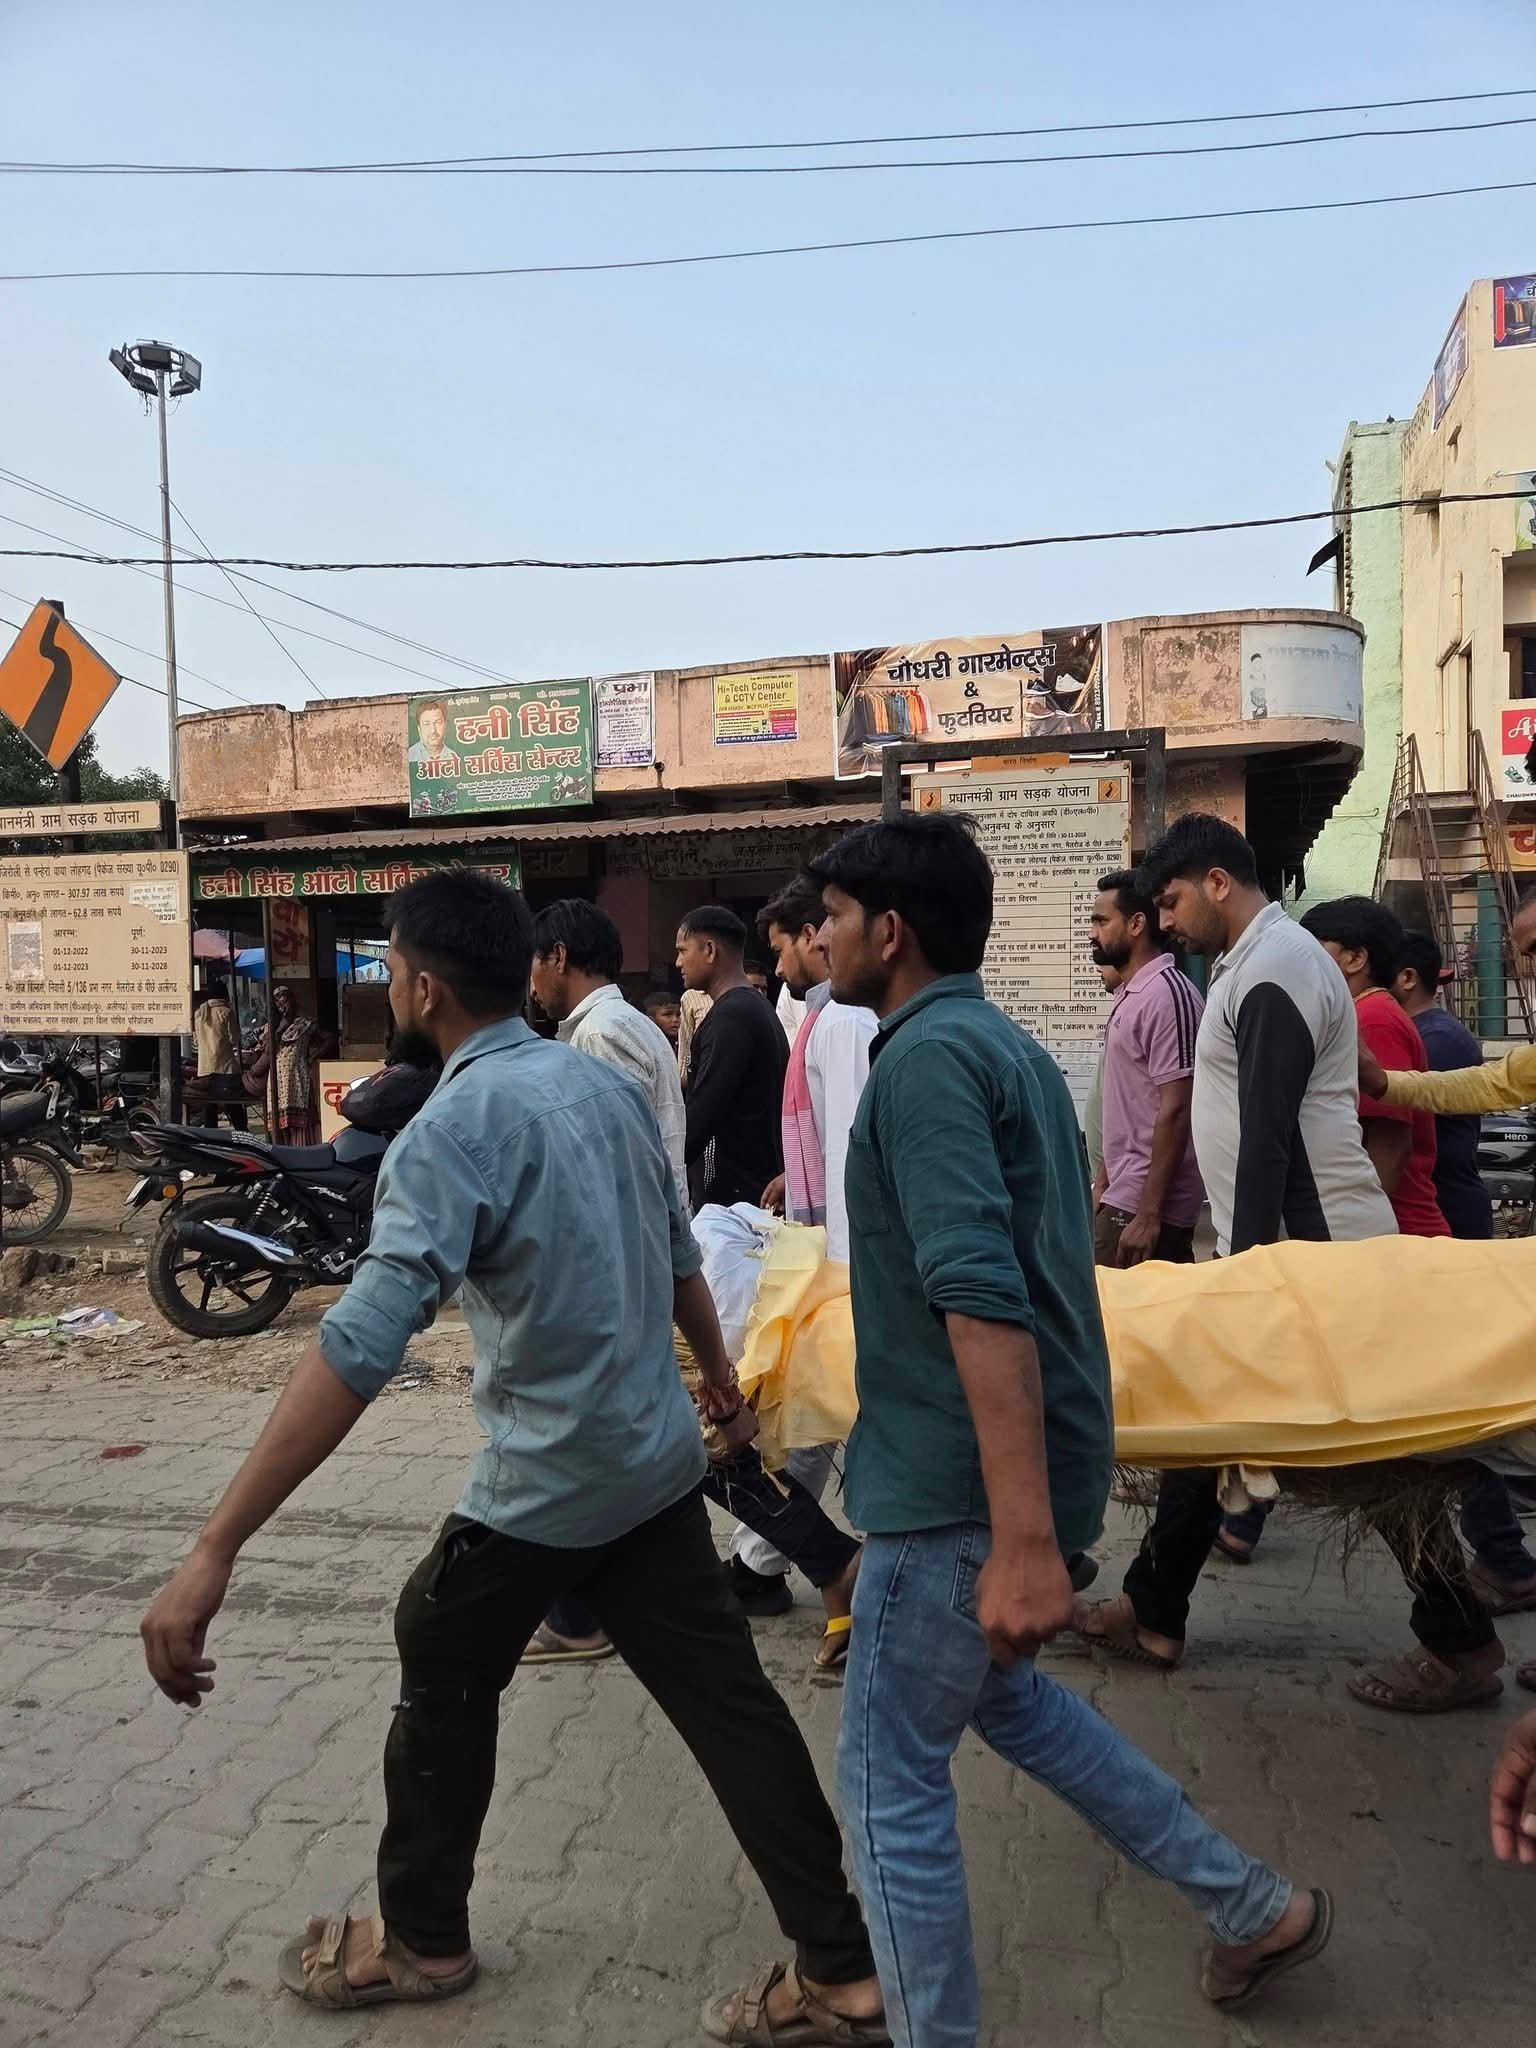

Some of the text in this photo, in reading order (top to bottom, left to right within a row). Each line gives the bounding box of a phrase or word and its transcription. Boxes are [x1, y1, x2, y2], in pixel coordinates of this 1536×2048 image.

[717, 681, 793, 694] Hi-Tech Computer
[963, 681, 980, 698] &
[733, 693, 755, 703] CCTV
[757, 691, 786, 701] Center
[455, 700, 581, 743] हनी सिंह
[937, 703, 1014, 734] फुटवियर
[464, 746, 522, 775] सर्विस
[526, 743, 581, 770] सेन्टर
[949, 784, 1090, 803] प्रधानमंत्री ग्राम सड़क योजना
[40, 814, 61, 827] ग्राम
[104, 807, 140, 825] योजना
[1014, 820, 1022, 830] के
[1027, 820, 1055, 832] अनुसार
[199, 868, 242, 898] हनी
[248, 865, 295, 898] सिंह
[301, 864, 357, 894] ऑटो
[68, 888, 90, 899] 307.97
[53, 946, 168, 956] 01-12-2022 30-11-2023
[53, 962, 168, 971] 01-12-2023 30-11-2028
[67, 980, 88, 993] 5/136
[1504, 1133, 1528, 1141] Hero
